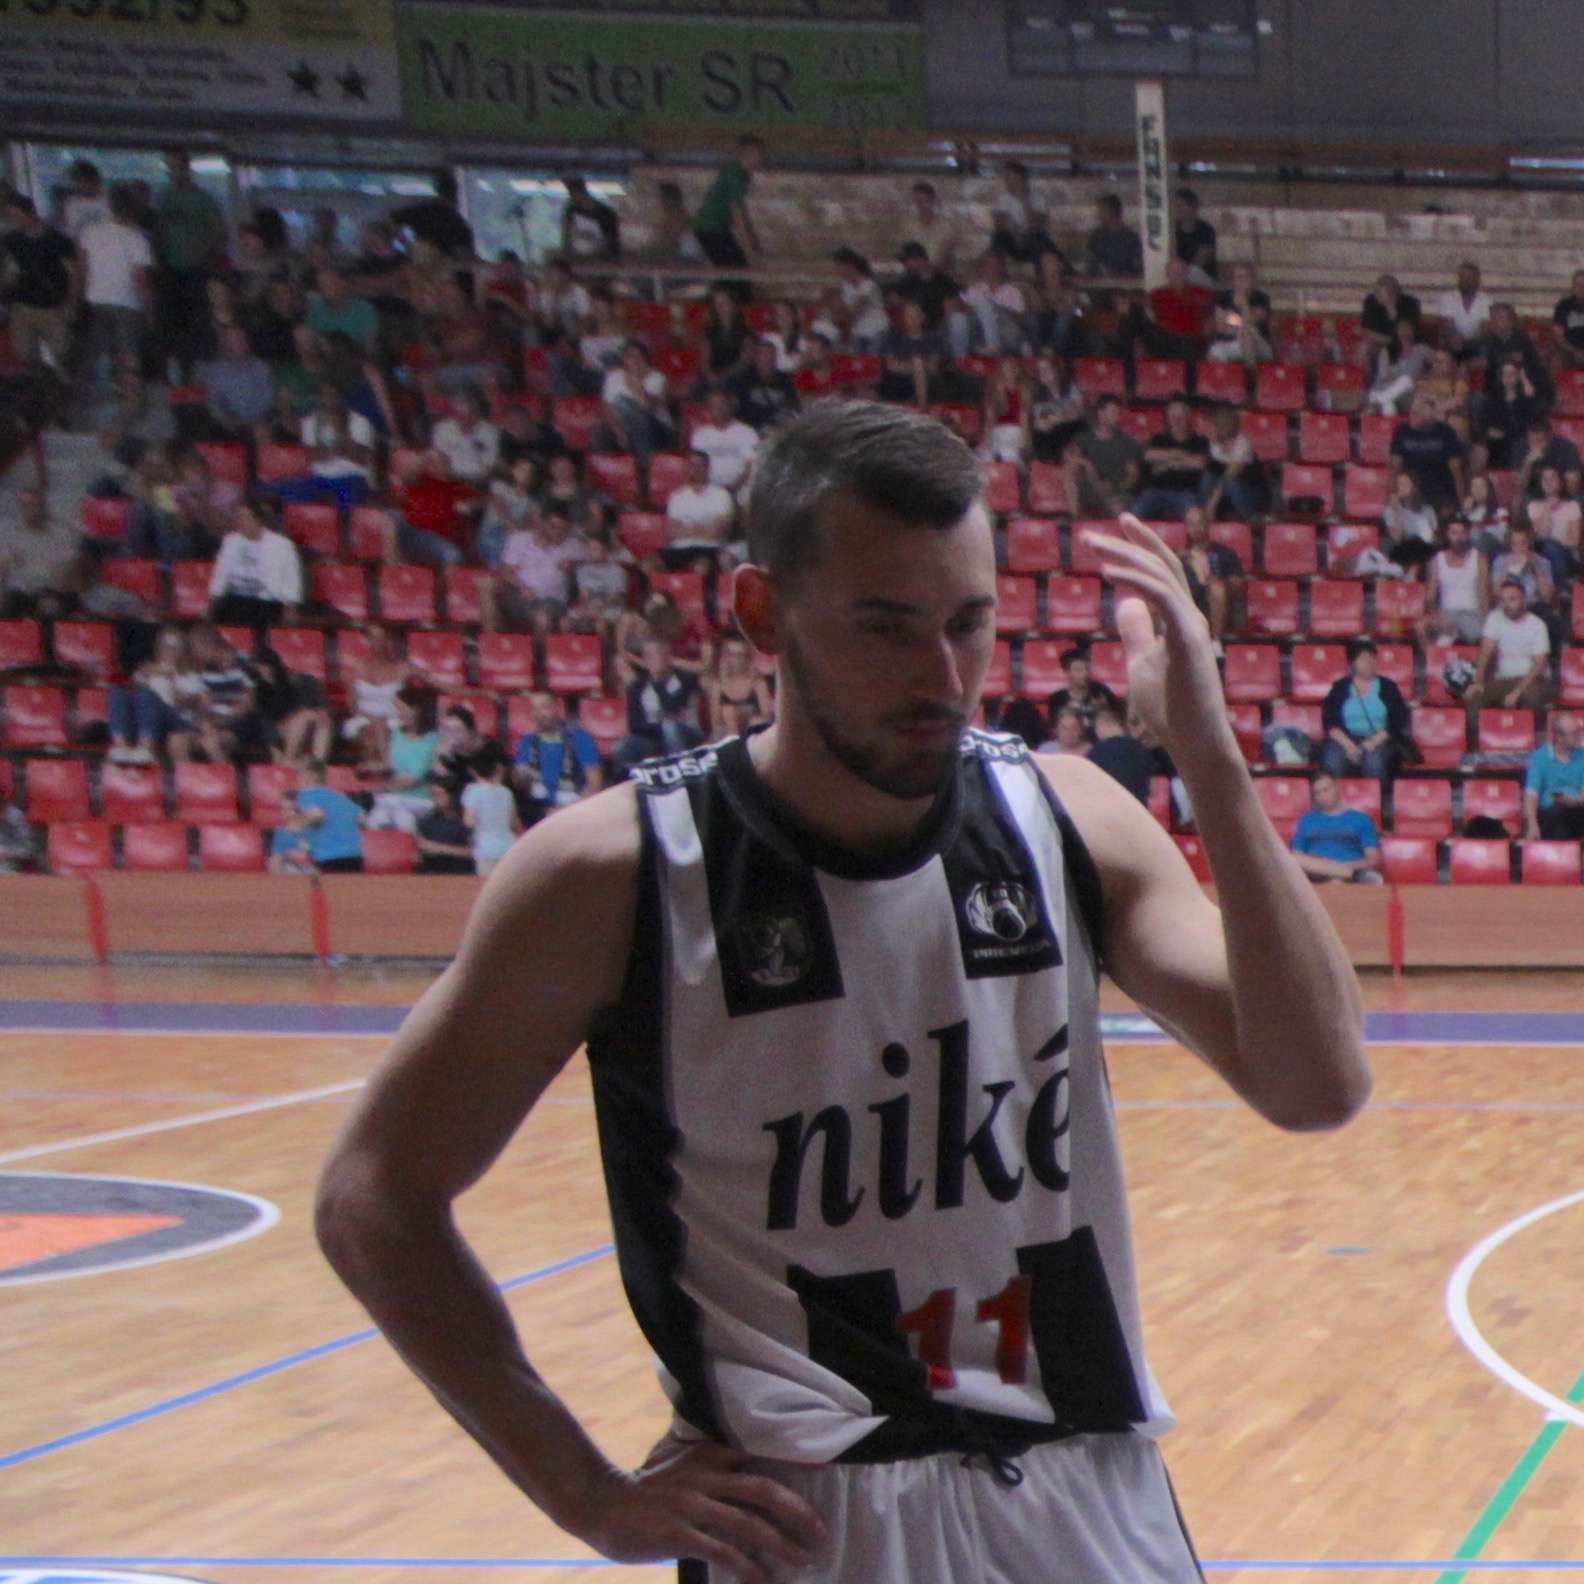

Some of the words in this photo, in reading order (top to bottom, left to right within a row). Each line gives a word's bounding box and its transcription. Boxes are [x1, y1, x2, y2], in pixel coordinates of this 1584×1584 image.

[418, 36, 677, 123] Majster
[701, 50, 795, 114] SR
[761, 1018, 1070, 1232] niké
[896, 1275, 1034, 1391] 11
